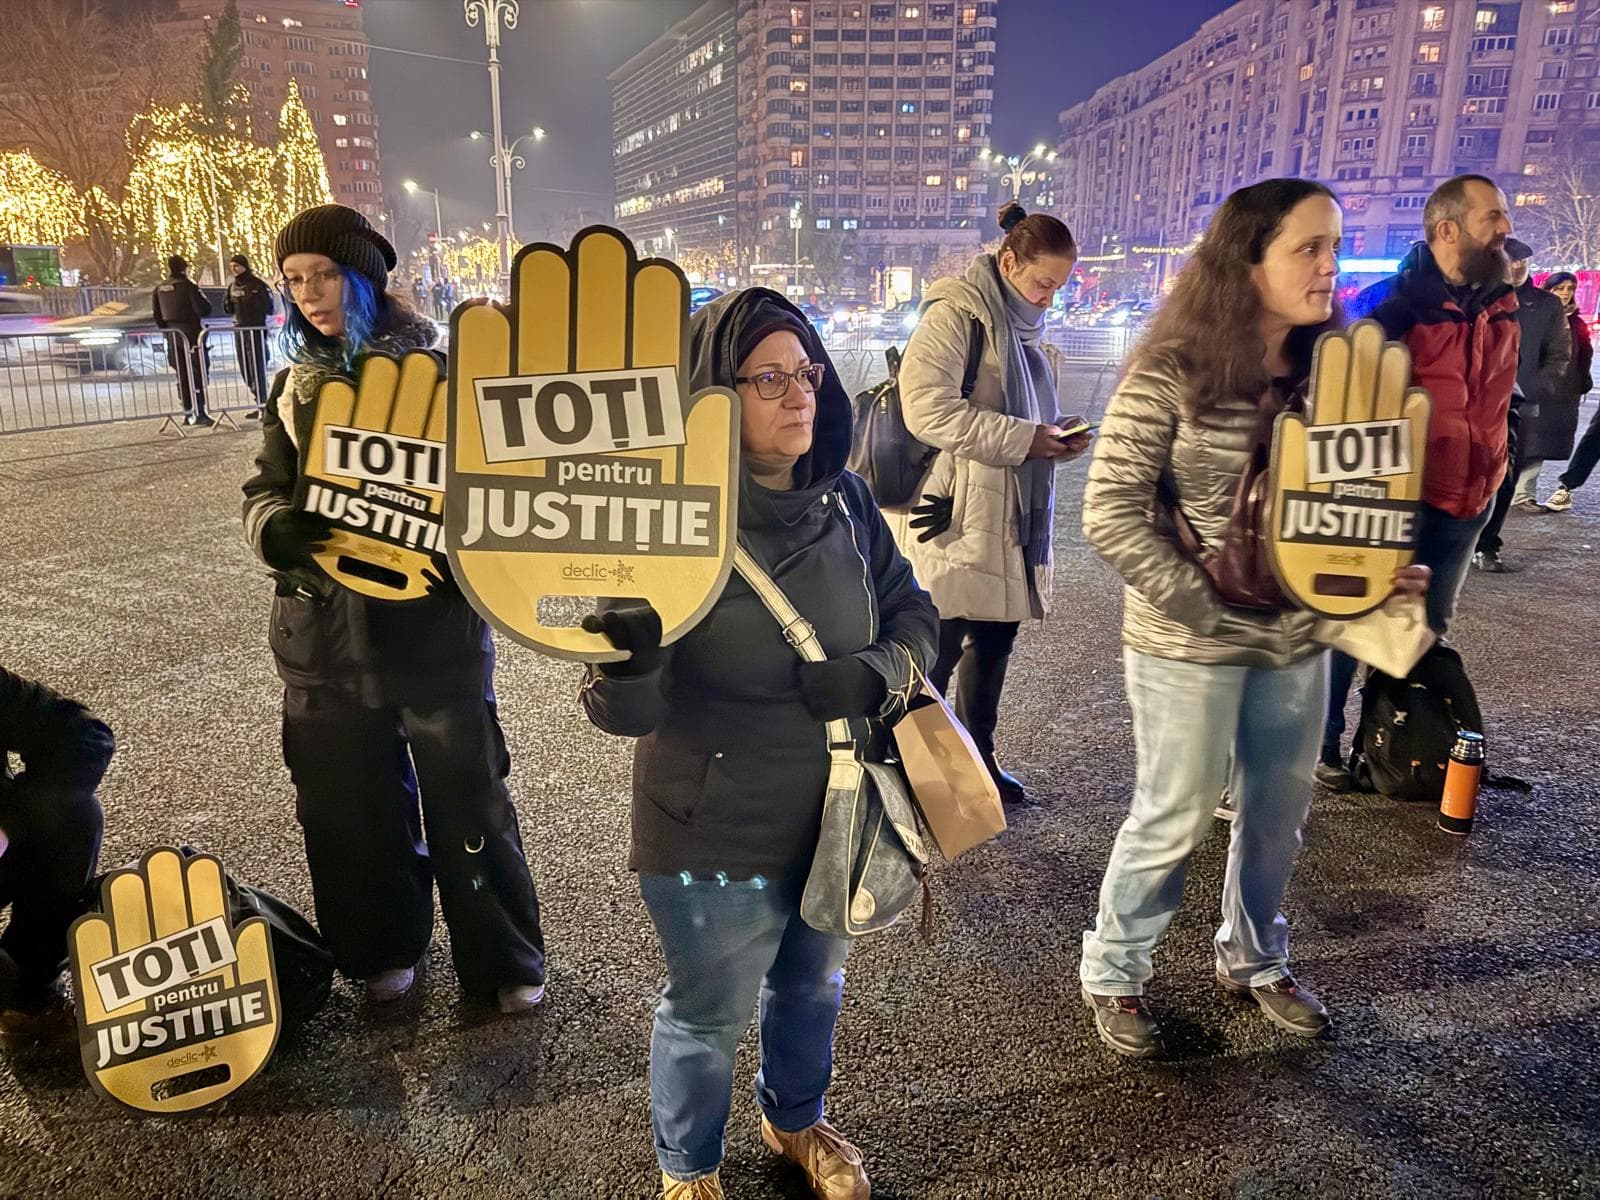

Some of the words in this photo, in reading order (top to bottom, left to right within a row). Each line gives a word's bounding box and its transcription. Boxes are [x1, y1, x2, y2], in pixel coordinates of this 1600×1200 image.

[482, 376, 666, 449] TOȚI
[330, 430, 442, 485] TOȚI
[558, 460, 653, 487] pentru
[1311, 425, 1401, 475] TOȚI
[365, 483, 428, 512] pentru
[460, 487, 712, 552] JUSTIȚIE
[1282, 499, 1416, 546] JUSTIȚIE
[562, 562, 608, 579] declic
[96, 925, 223, 1001] TOȚI
[153, 982, 218, 1011] pentru
[96, 991, 265, 1068] JUSTIȚIE
